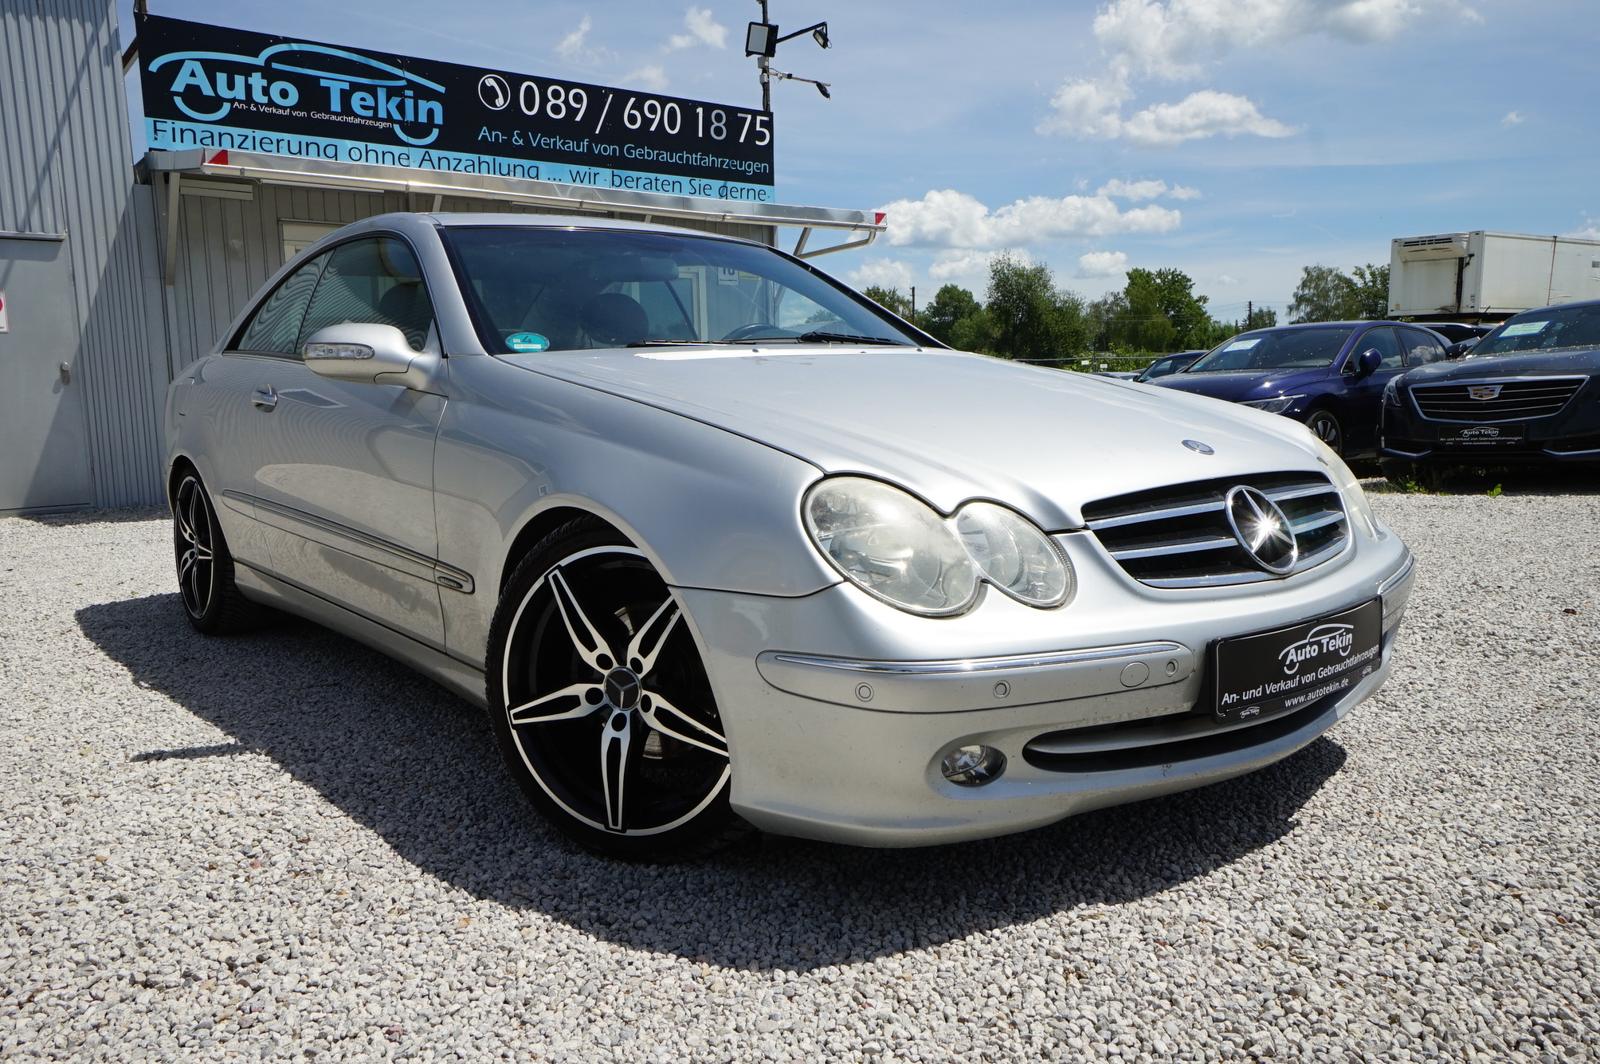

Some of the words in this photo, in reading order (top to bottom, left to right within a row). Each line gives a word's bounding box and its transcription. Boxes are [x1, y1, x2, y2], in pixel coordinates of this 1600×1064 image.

[170, 59, 300, 107] Auto
[319, 78, 444, 126] Tekin
[233, 101, 248, 110] An-
[250, 104, 257, 112] &
[258, 105, 290, 116] Verkauf
[291, 110, 308, 118] von
[310, 111, 393, 129] Gebrauchtfahrzeugen
[518, 80, 588, 122] 089
[595, 93, 614, 135] /
[622, 97, 682, 135] 690
[696, 106, 728, 141] 18
[737, 112, 771, 147] 75
[153, 119, 338, 162] Finanzierung
[348, 144, 410, 168] ohne
[418, 150, 540, 180] Anzahlung
[569, 167, 600, 185] wir
[610, 170, 682, 194] beraten
[688, 178, 713, 197] Sie
[718, 183, 768, 202] gerne
[478, 126, 508, 143] An-
[512, 130, 525, 147] &
[528, 132, 590, 154] Verkauf
[592, 143, 619, 157] von
[624, 143, 770, 176] Gebrauchtfahrzeugen
[1221, 693, 1240, 706] An-
[1242, 685, 1263, 700] und
[1265, 674, 1300, 695] Verkauf
[1301, 672, 1316, 685] von
[1317, 644, 1380, 679] Gebrauchtfahrzeugen
[1286, 645, 1319, 665] Auto
[1321, 632, 1353, 653] Tekin
[1284, 678, 1349, 708] www.autotekin.de
